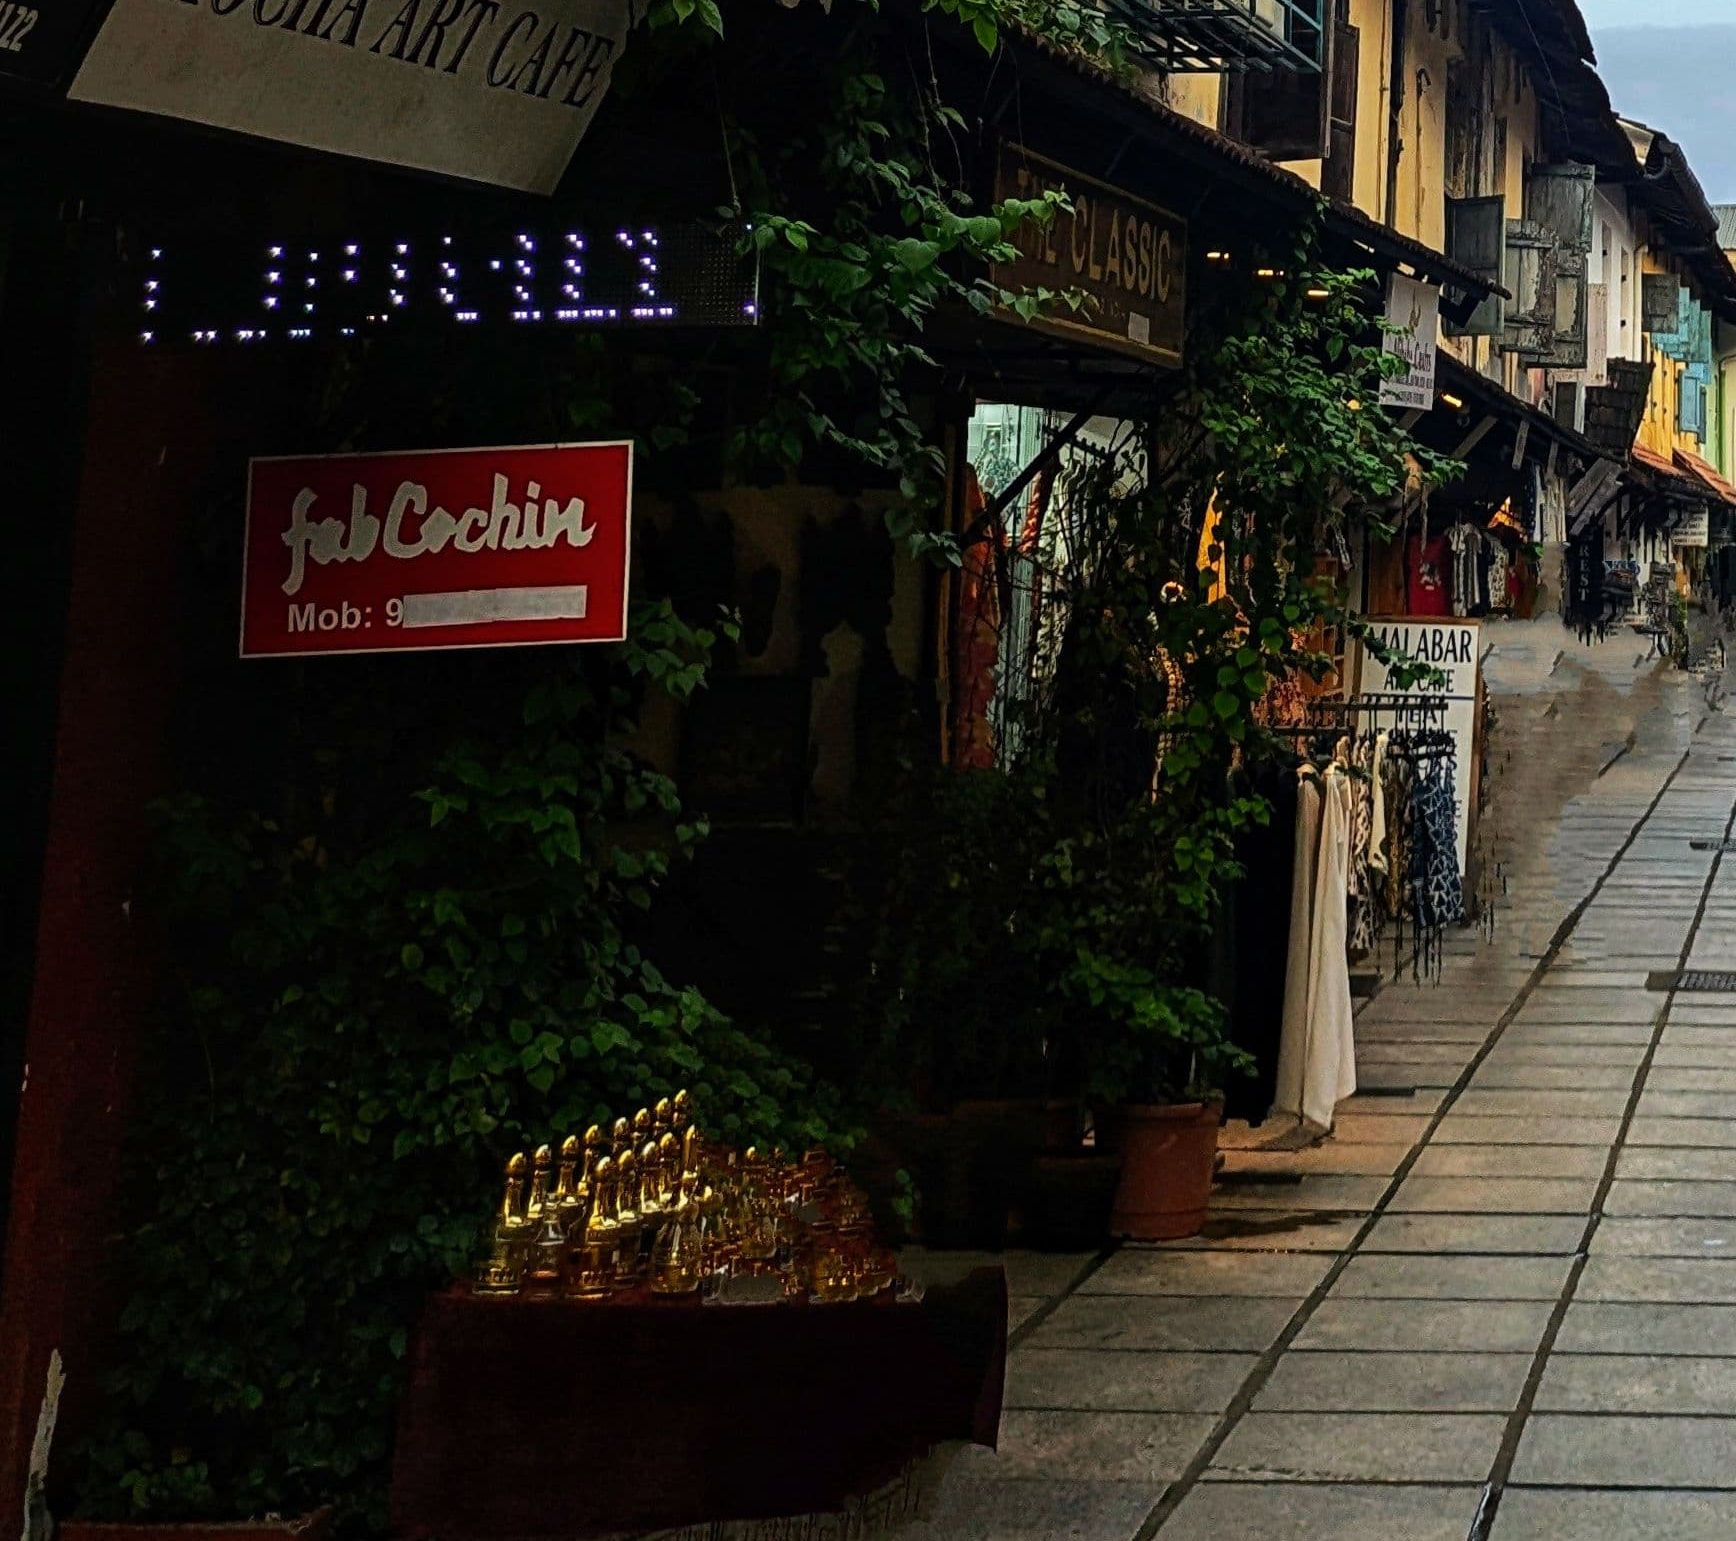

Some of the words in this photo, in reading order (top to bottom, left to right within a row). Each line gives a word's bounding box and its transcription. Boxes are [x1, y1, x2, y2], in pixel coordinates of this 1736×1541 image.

[486, 11, 617, 109] CAFE
[1071, 195, 1171, 303] CLASSIC
[288, 601, 372, 632] Mob:
